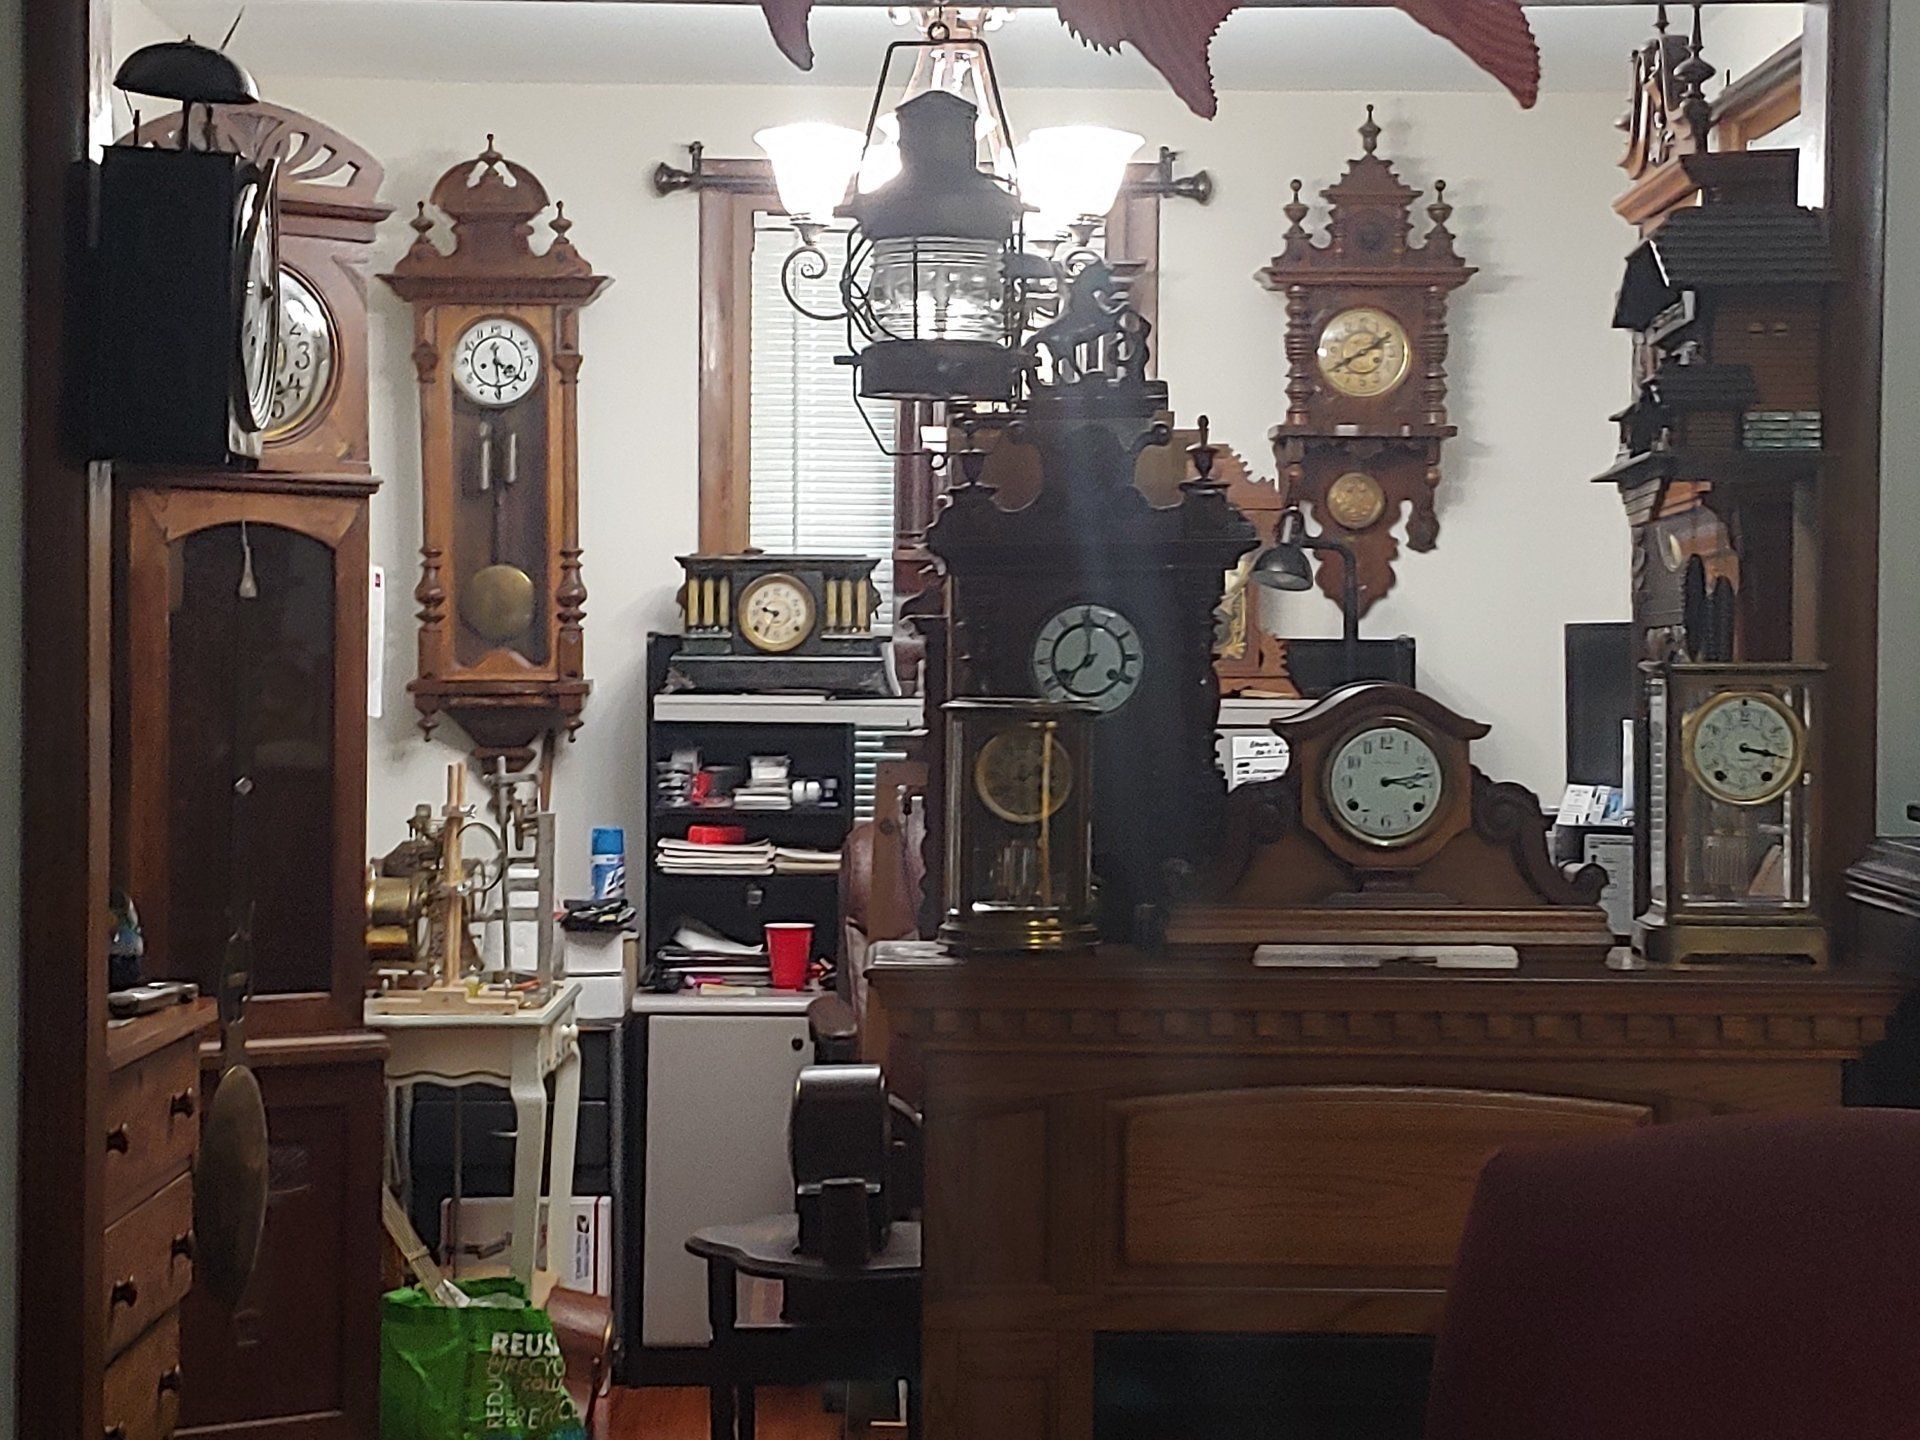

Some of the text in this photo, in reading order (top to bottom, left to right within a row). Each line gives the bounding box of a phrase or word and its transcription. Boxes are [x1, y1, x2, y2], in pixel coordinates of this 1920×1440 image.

[294, 341, 310, 370] 3
[285, 372, 304, 398] 4
[1380, 735, 1393, 750] 12
